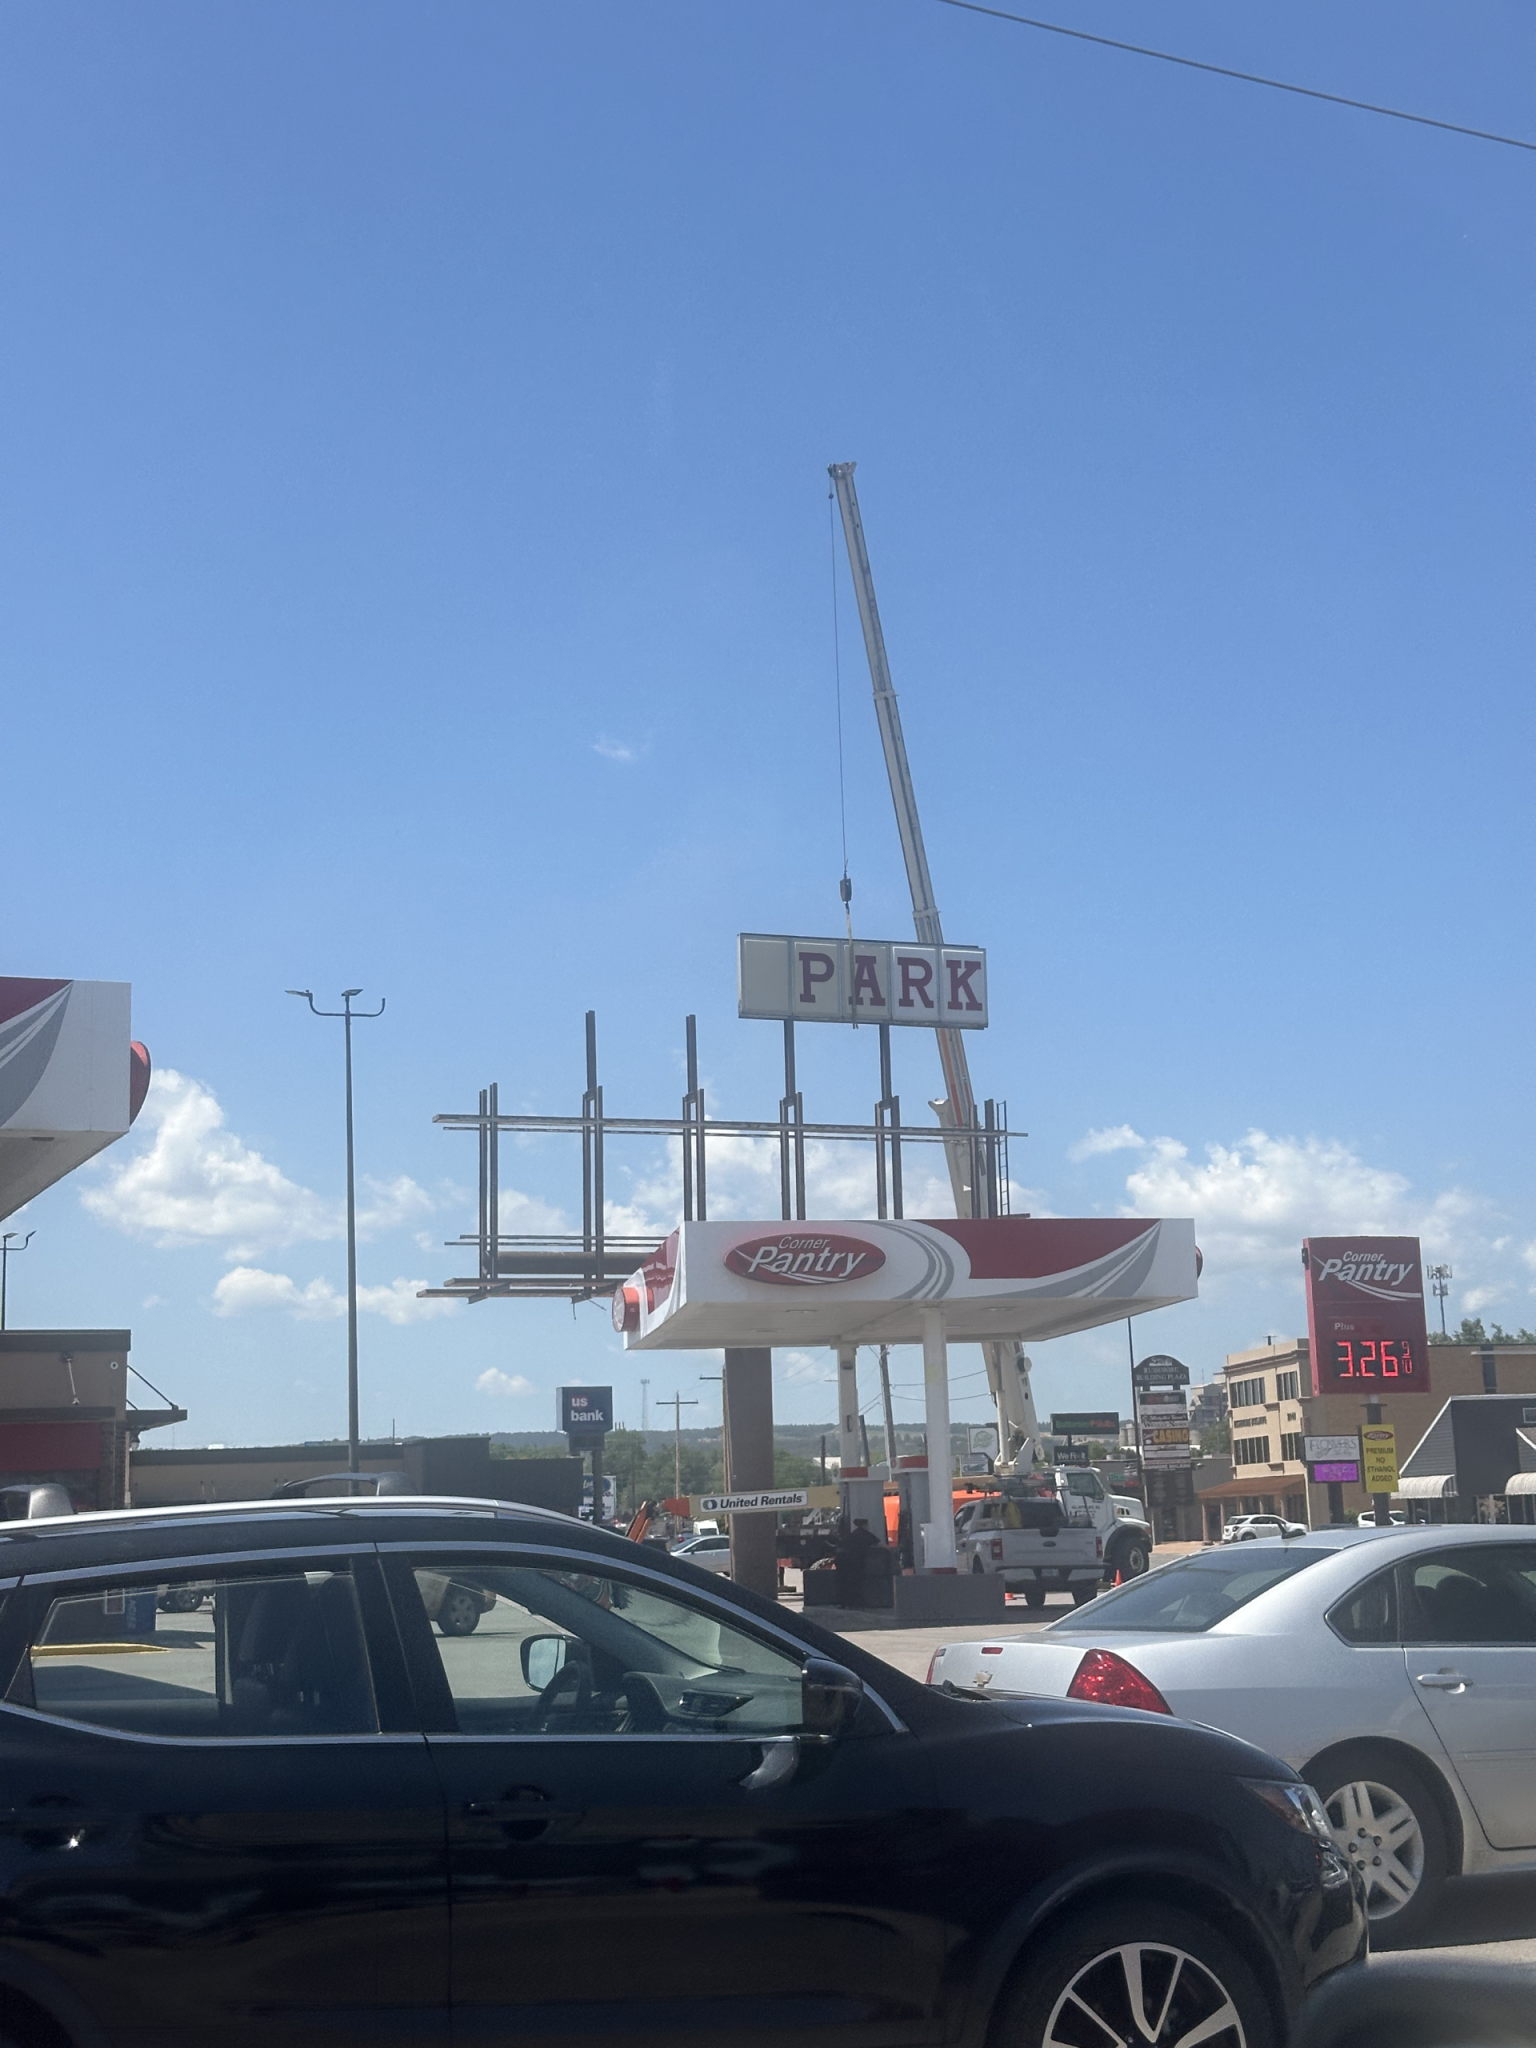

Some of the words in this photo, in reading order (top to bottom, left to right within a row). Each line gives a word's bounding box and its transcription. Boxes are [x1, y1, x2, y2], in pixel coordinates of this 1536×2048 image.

[798, 951, 983, 1012] PARK
[778, 1236, 830, 1249] Corner
[748, 1245, 867, 1278] Pantry
[1343, 1251, 1384, 1262] Corner
[1318, 1258, 1414, 1286] Pantry
[1334, 1322, 1355, 1331] Plus
[1336, 1340, 1399, 1377] 3.26
[1167, 1373, 1187, 1381] PLAZA
[571, 1397, 588, 1407] us
[570, 1409, 604, 1422] bank
[1153, 1429, 1189, 1444] CASINO
[1309, 1438, 1358, 1451] FLOWERS
[1366, 1447, 1394, 1455] PREMIUM
[1375, 1456, 1386, 1464] NO
[1367, 1465, 1396, 1473] ETHANOL
[1371, 1474, 1393, 1482] ADDED
[720, 1496, 758, 1509] United
[760, 1493, 803, 1506] Rentals
